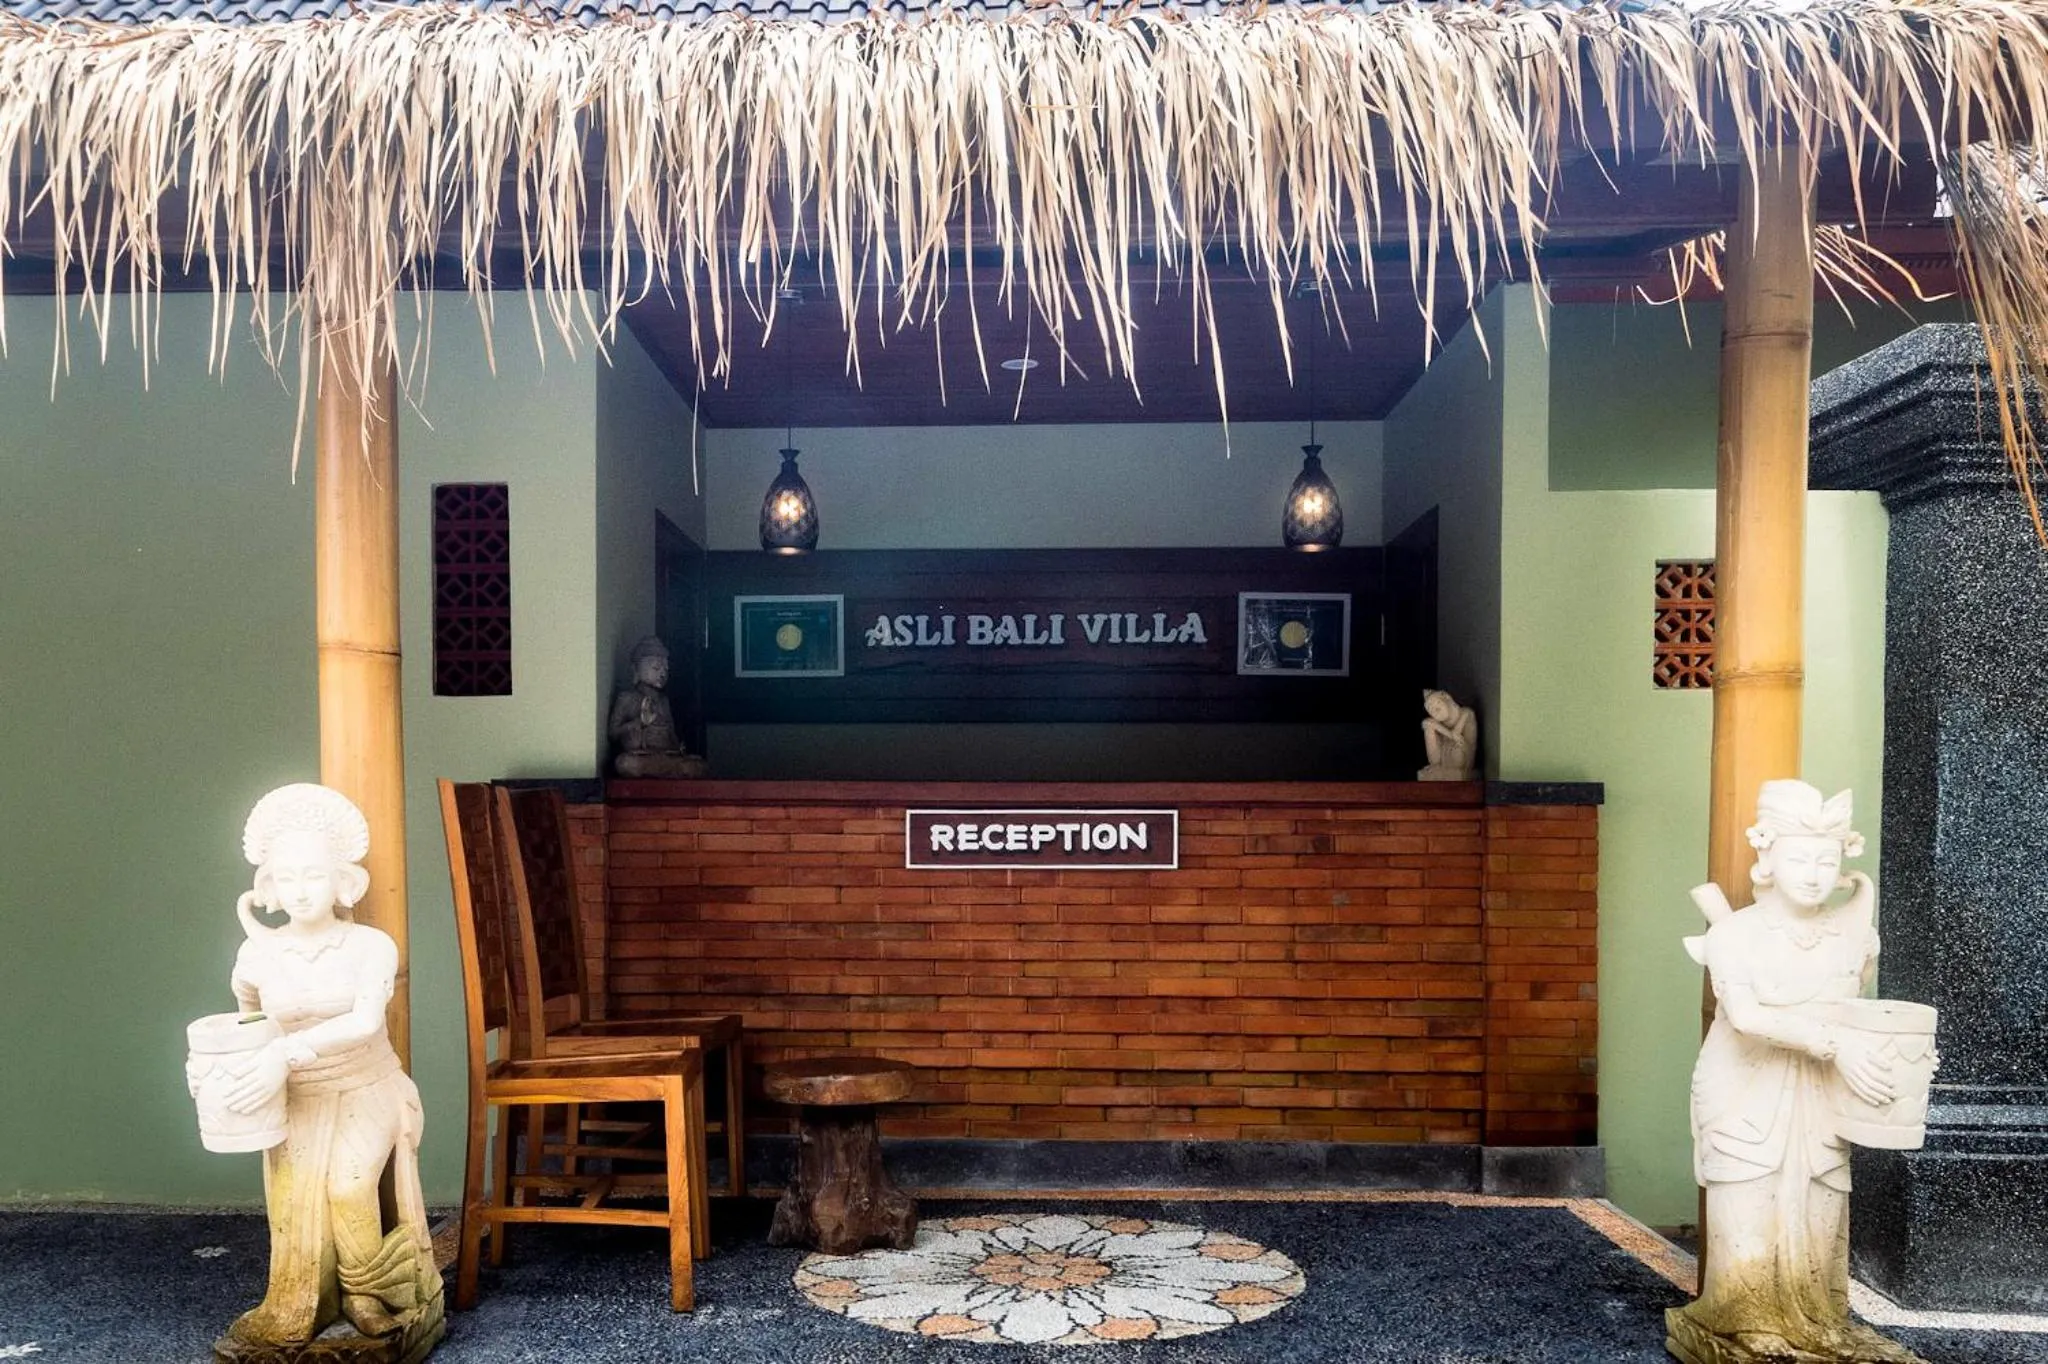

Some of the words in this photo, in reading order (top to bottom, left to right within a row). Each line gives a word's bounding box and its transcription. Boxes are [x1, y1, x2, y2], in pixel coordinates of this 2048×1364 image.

[866, 614, 956, 647] ASLI
[967, 614, 1065, 645] BALI
[1078, 612, 1207, 644] VILLA
[930, 822, 1148, 851] RECEPTION
